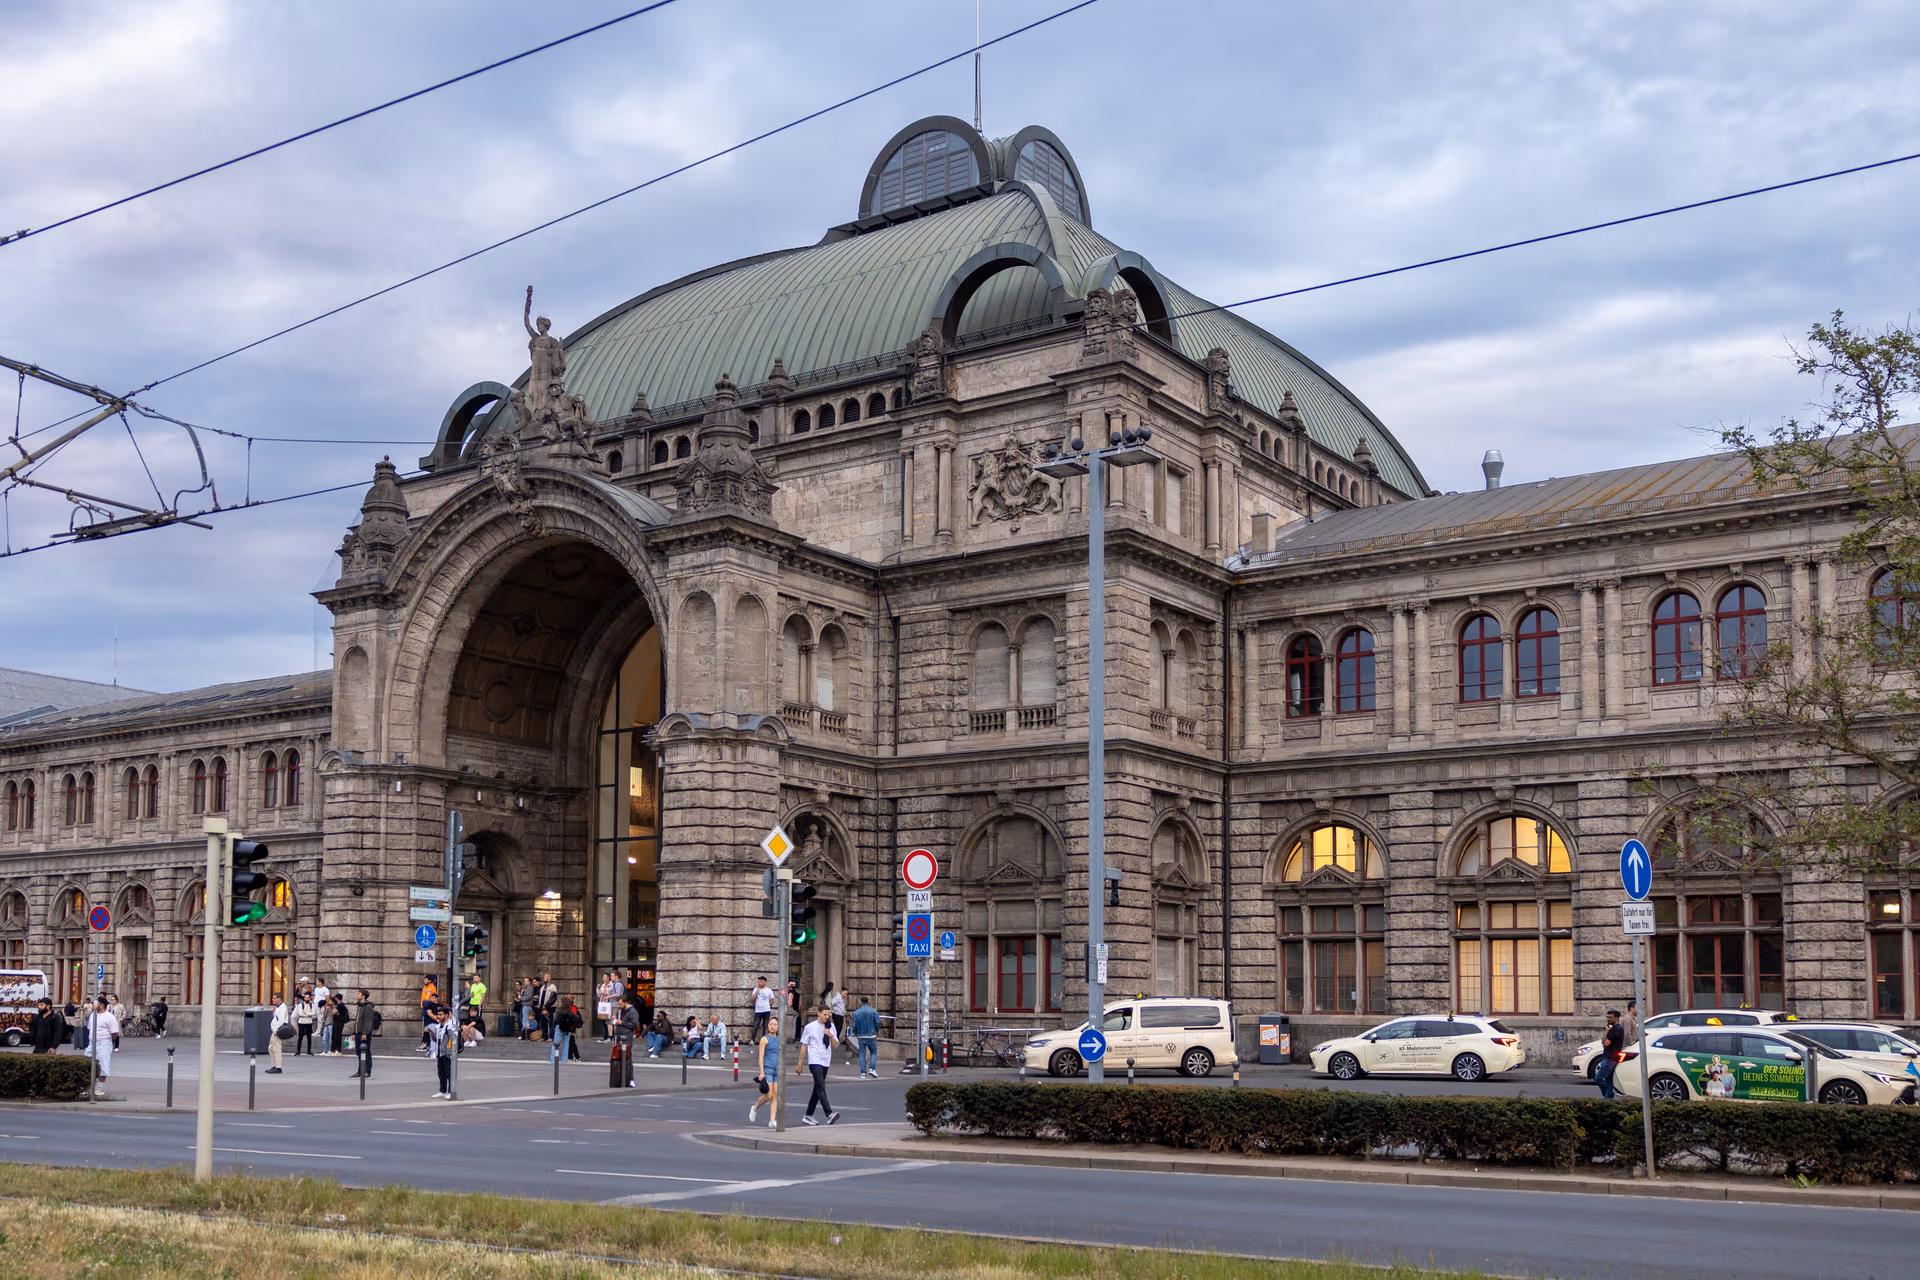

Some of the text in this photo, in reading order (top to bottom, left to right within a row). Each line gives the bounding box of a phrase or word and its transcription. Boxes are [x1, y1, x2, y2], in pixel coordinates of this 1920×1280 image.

[910, 893, 929, 902] TAXI
[1623, 907, 1639, 917] Zufahrt
[1629, 920, 1641, 929] Taxen
[908, 943, 929, 953] TAXI
[26, 989, 35, 998] go
[1763, 1065, 1805, 1076] DER SOUND
[1742, 1072, 1805, 1084] DEINES SOMMERS
